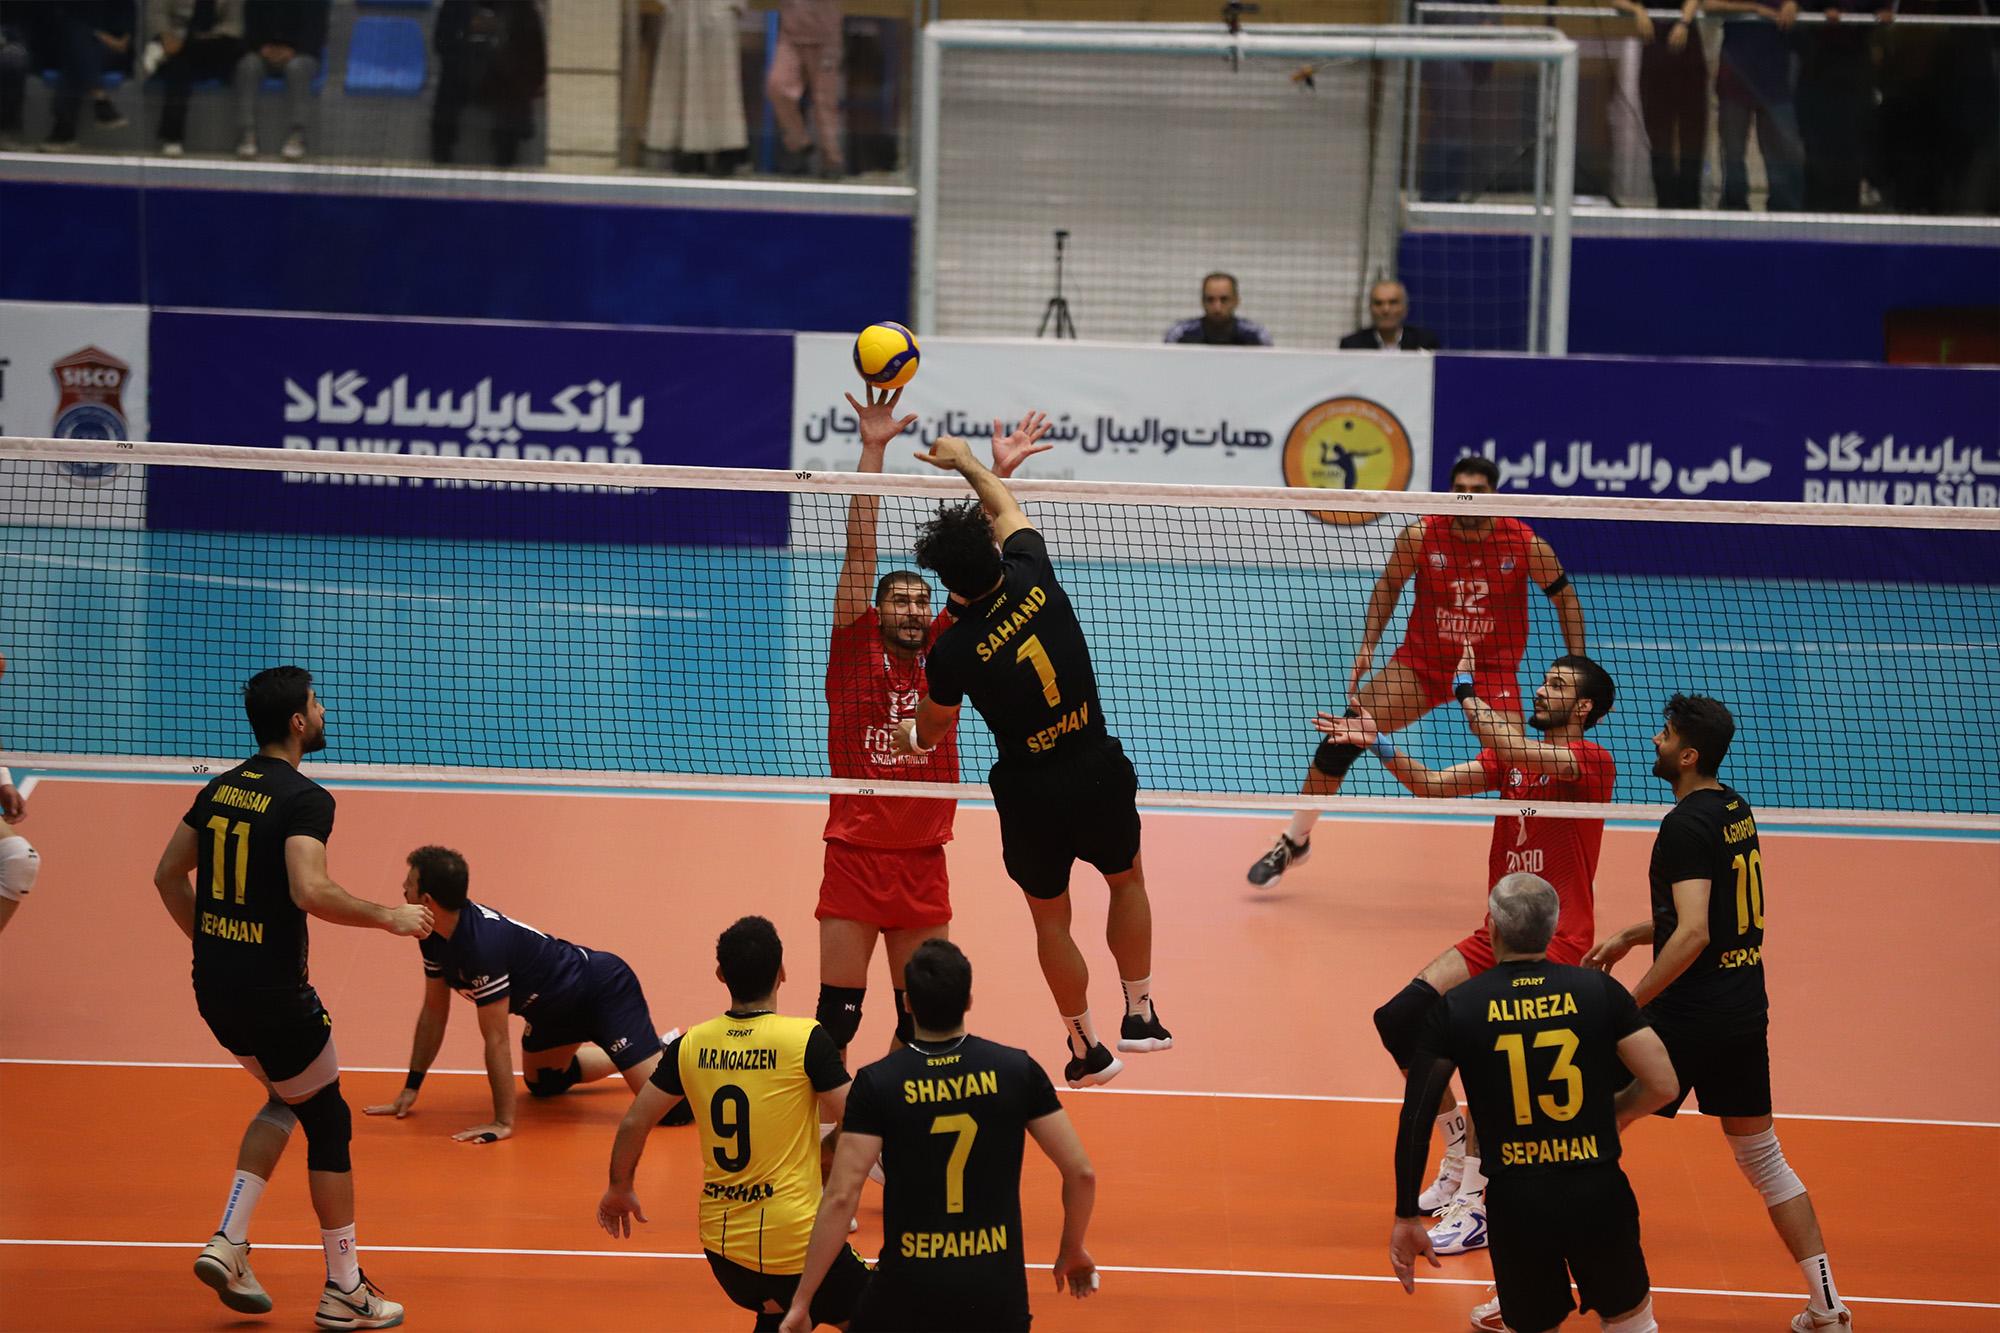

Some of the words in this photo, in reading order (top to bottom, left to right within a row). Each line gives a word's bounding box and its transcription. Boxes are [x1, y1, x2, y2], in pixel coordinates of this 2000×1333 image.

[62, 366, 121, 387] SISCO
[284, 369, 523, 443] پاسارگاد
[516, 379, 645, 446] بانک
[1081, 417, 1179, 454] والیبال
[1551, 441, 1673, 494] والیبال
[1678, 446, 1772, 495] حامی
[1804, 430, 1976, 485] پاسارگاد
[1450, 580, 1490, 614] 12
[975, 585, 1048, 662] SAHAND
[1015, 633, 1062, 709] 1
[206, 815, 251, 905] 11
[1732, 848, 1764, 936] 10
[201, 911, 264, 944] SEPAHAN
[1511, 976, 1546, 987] START
[1487, 992, 1579, 1023] ALIREZA
[726, 1028, 755, 1037] START
[697, 1047, 777, 1070] M.R.MOAZZEN
[927, 1055, 962, 1067] START
[903, 1070, 998, 1104] SHAYAN
[1493, 1028, 1584, 1127] 13
[710, 1084, 751, 1173] 9
[1447, 1116, 1465, 1136] 10
[930, 1112, 978, 1213] 7
[1501, 1135, 1600, 1166] SEPAHAN
[901, 1225, 1007, 1258] SEPAHAN
